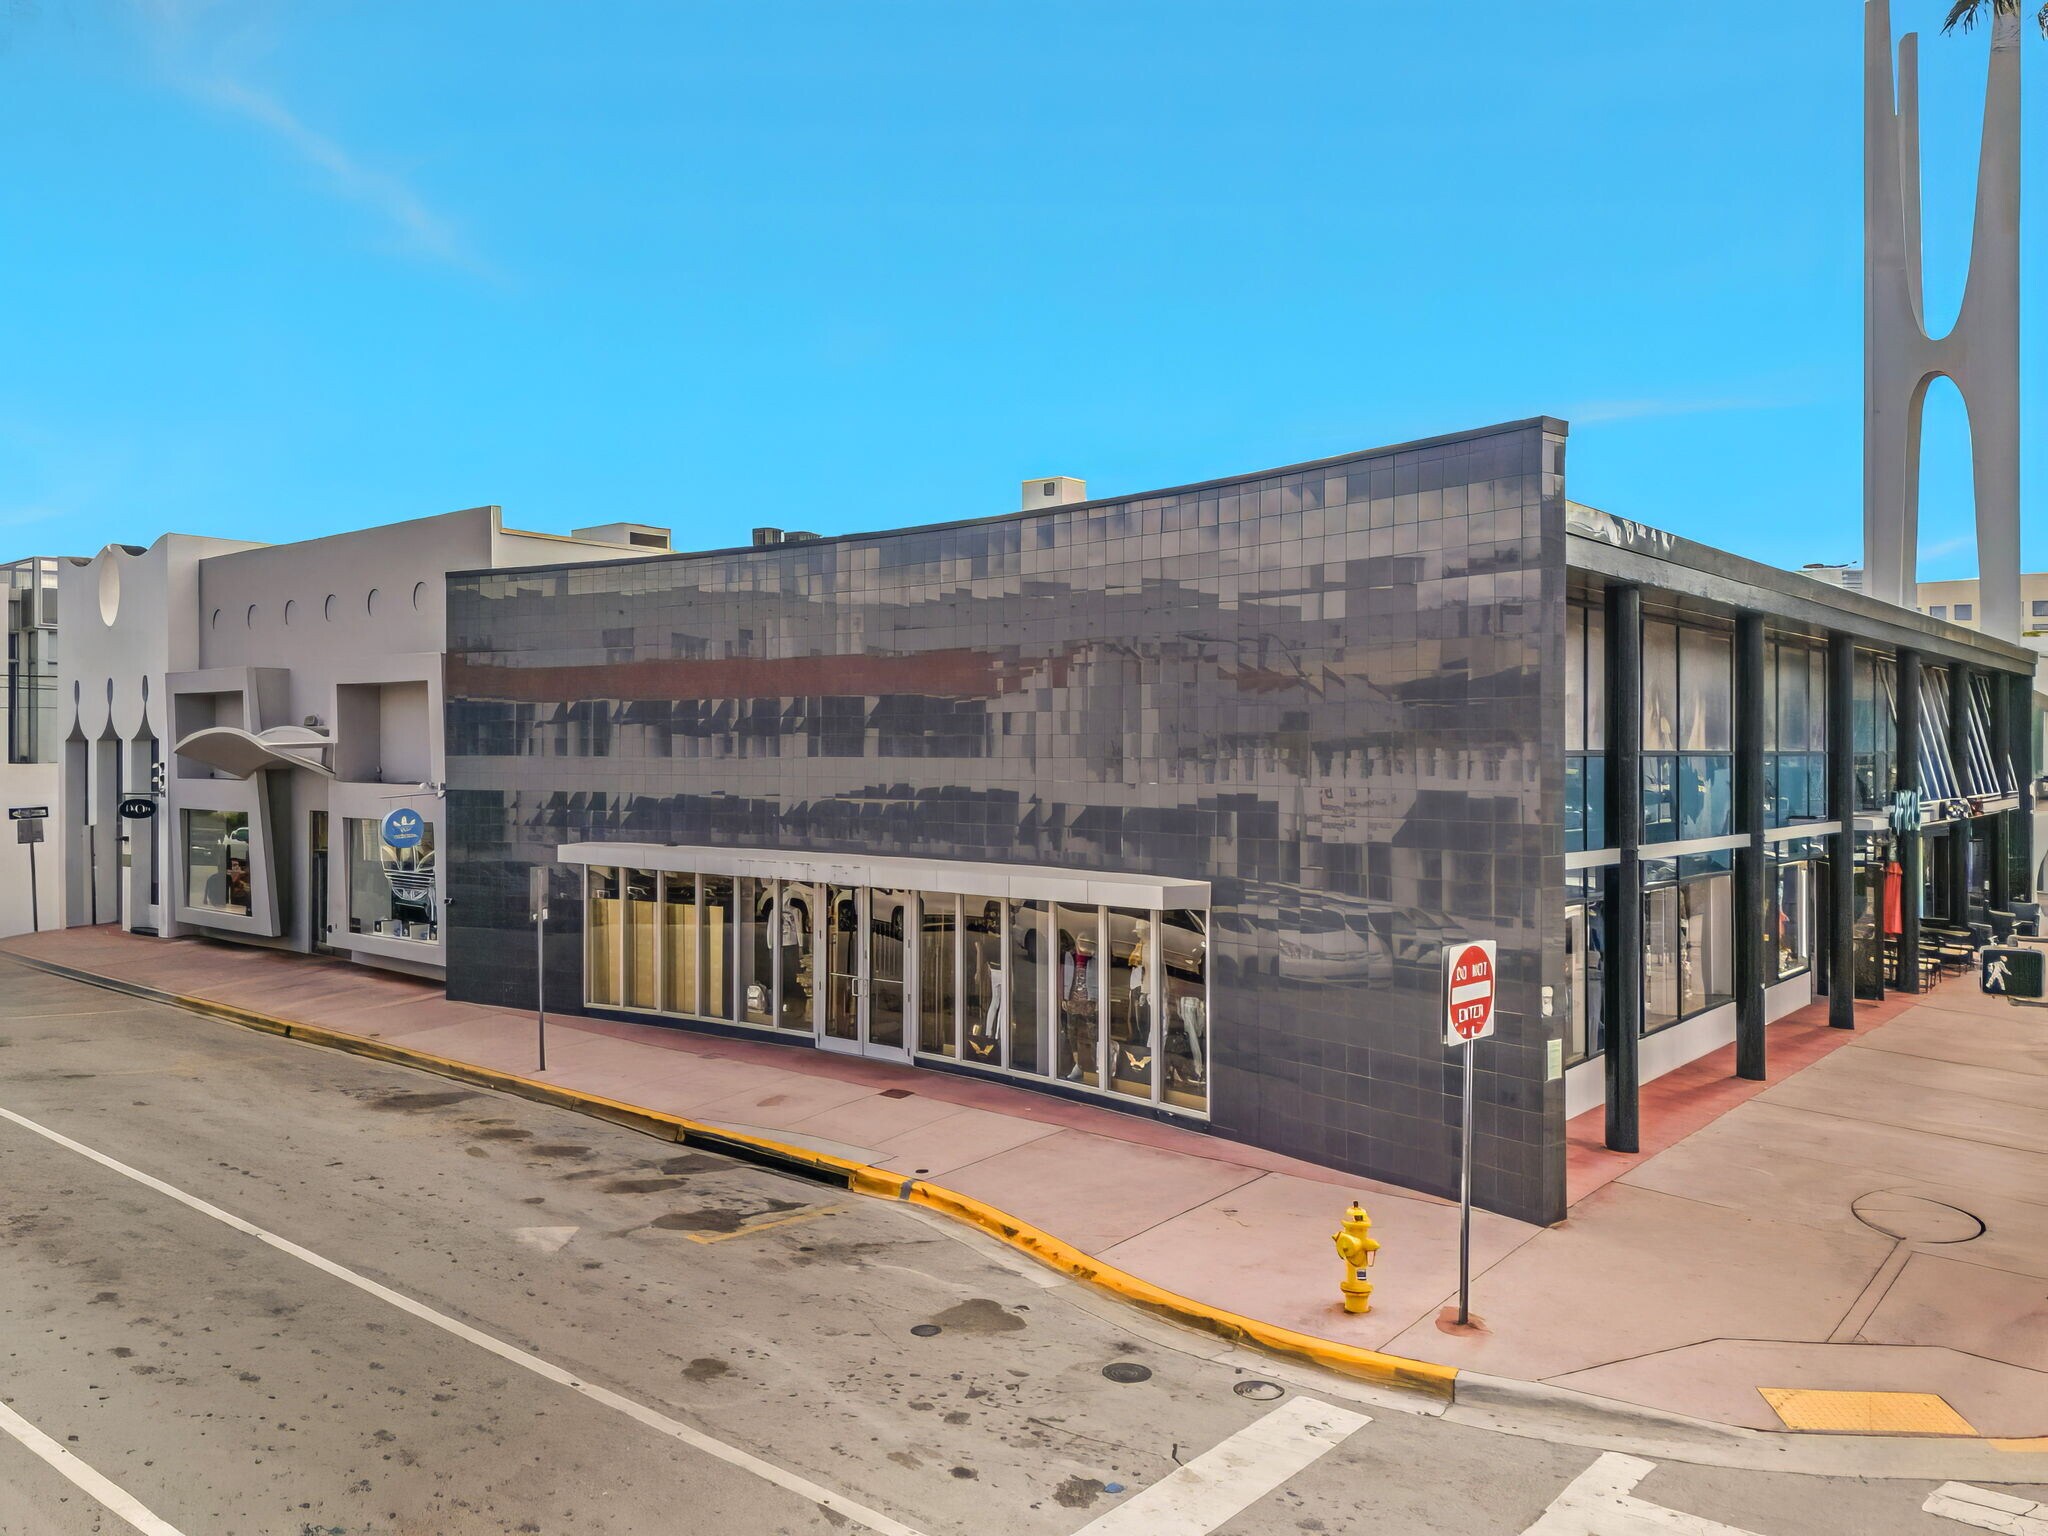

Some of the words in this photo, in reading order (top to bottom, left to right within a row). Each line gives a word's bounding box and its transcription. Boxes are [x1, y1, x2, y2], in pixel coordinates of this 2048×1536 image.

[1456, 966, 1467, 981] DO
[1472, 962, 1487, 977] NOT
[1458, 1004, 1483, 1022] ENTER
